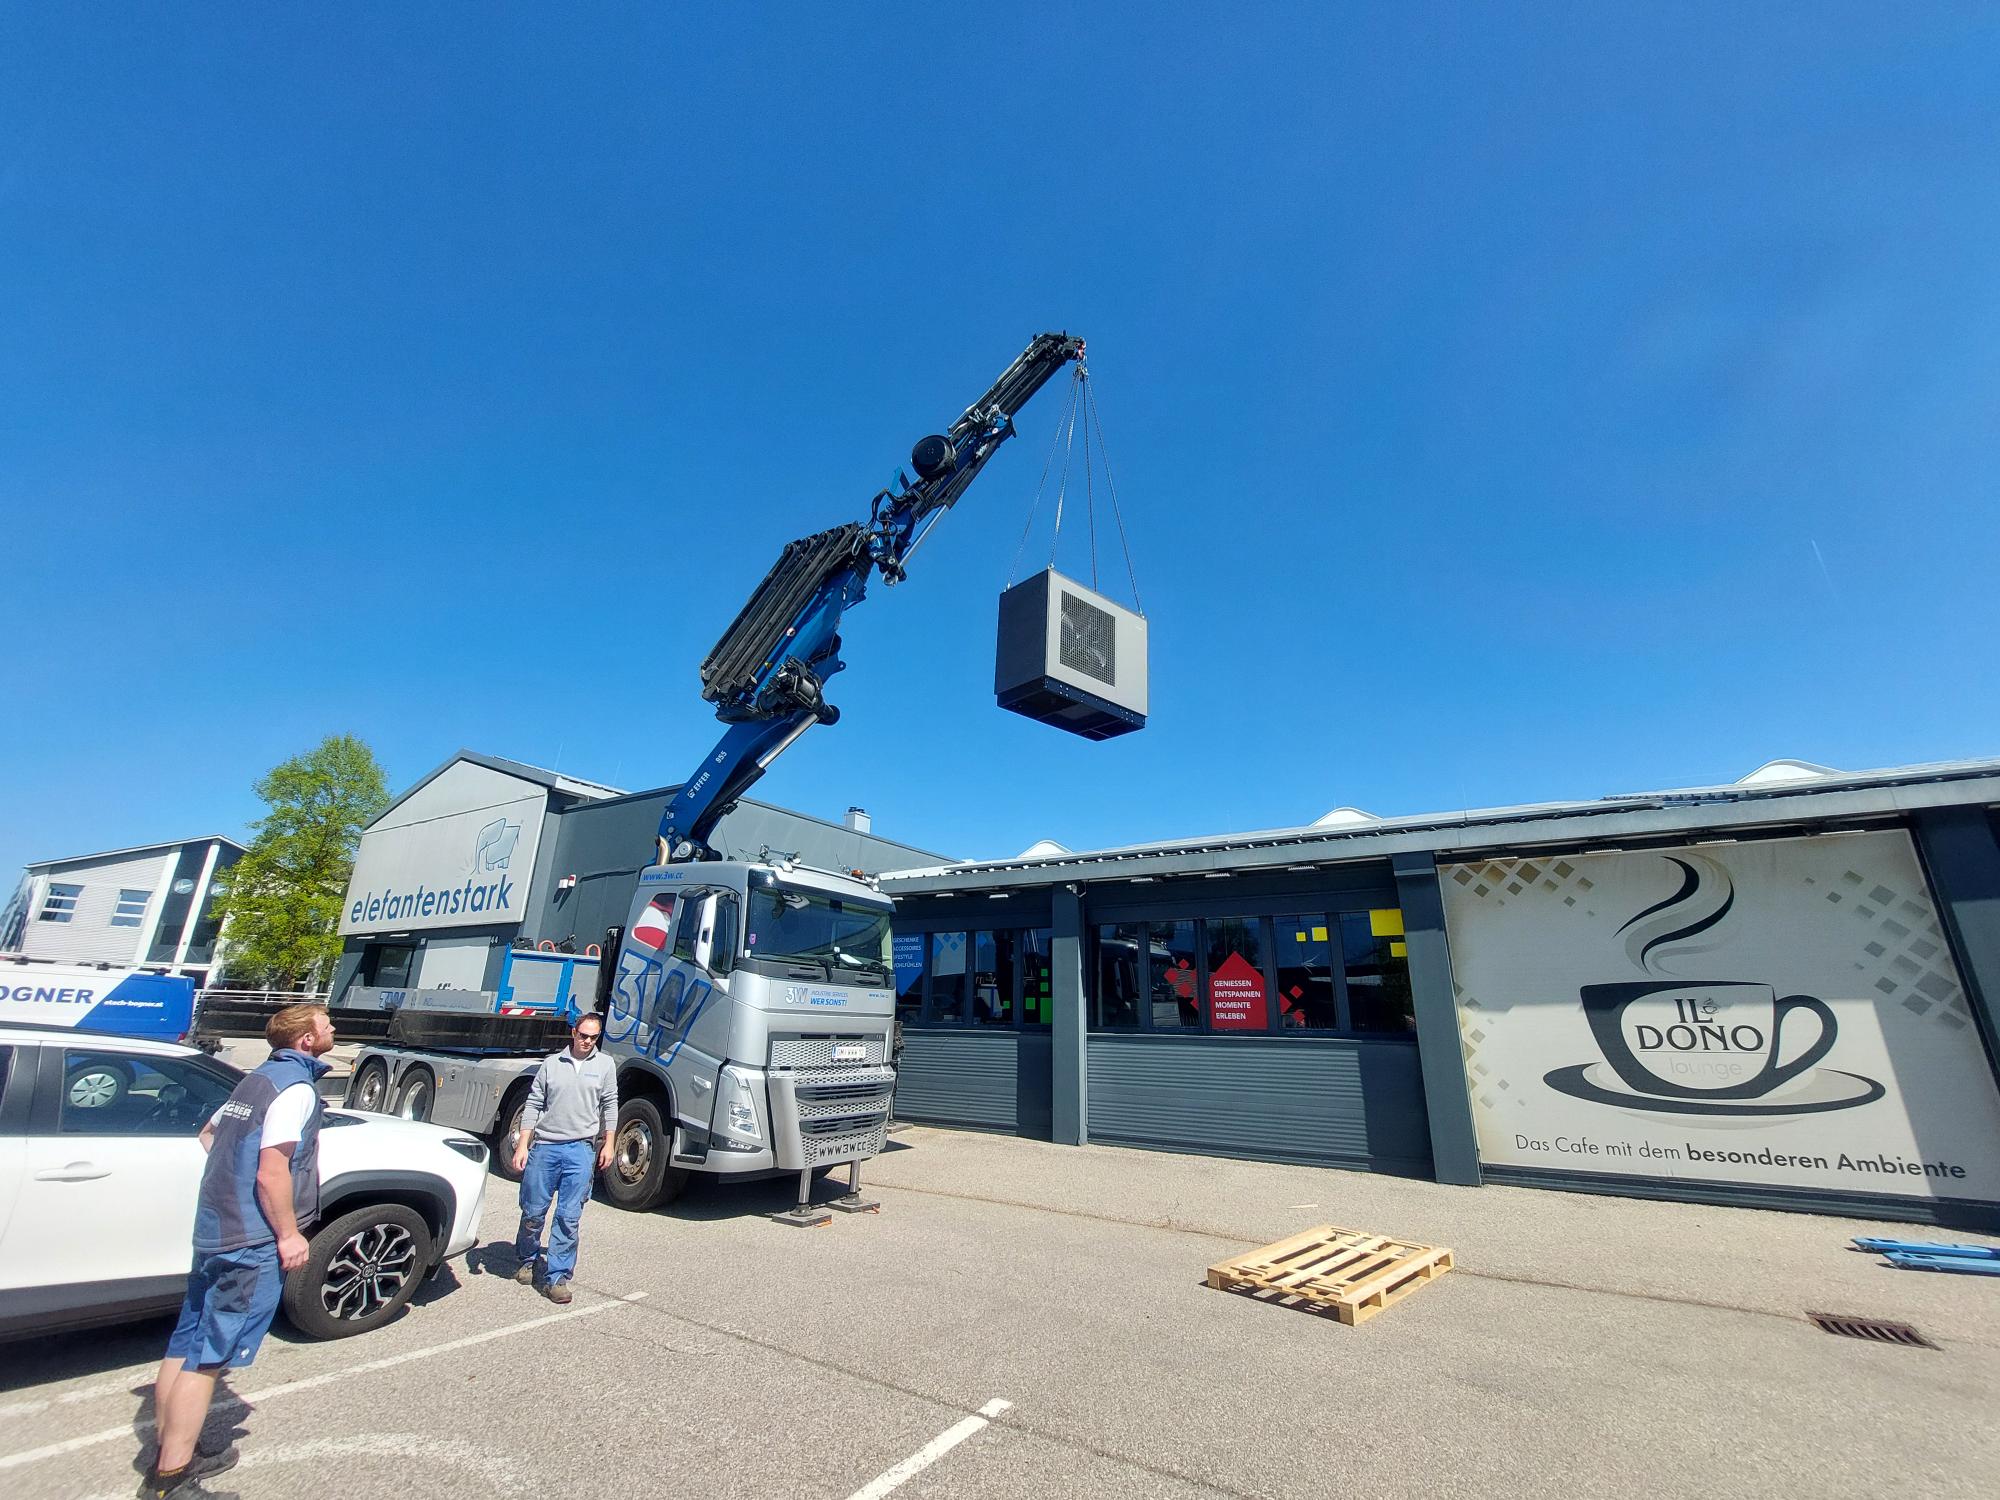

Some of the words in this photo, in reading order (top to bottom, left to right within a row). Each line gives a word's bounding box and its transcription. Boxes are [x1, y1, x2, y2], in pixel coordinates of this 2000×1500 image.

[715, 750, 727, 764] 955
[693, 771, 710, 791] EFFER
[351, 874, 514, 923] elefantenstark
[785, 987, 809, 1004] 3W
[810, 997, 825, 1005] WER
[1214, 990, 1261, 998] ENTSPANNEN
[604, 948, 712, 1067] 3W
[1215, 1001, 1252, 1009] MOMENTE
[1674, 999, 1714, 1023] IL
[1216, 1012, 1247, 1020] ERLEBEN
[1634, 1025, 1764, 1051] DONO
[1669, 1058, 1742, 1079] lounge
[1515, 1134, 1550, 1151] Das
[1555, 1137, 1599, 1155] Cafe
[1606, 1141, 1632, 1157] mit
[1639, 1141, 1681, 1160] dem
[1686, 1143, 1828, 1169] besonderen
[1836, 1153, 1967, 1179] Ambiente
